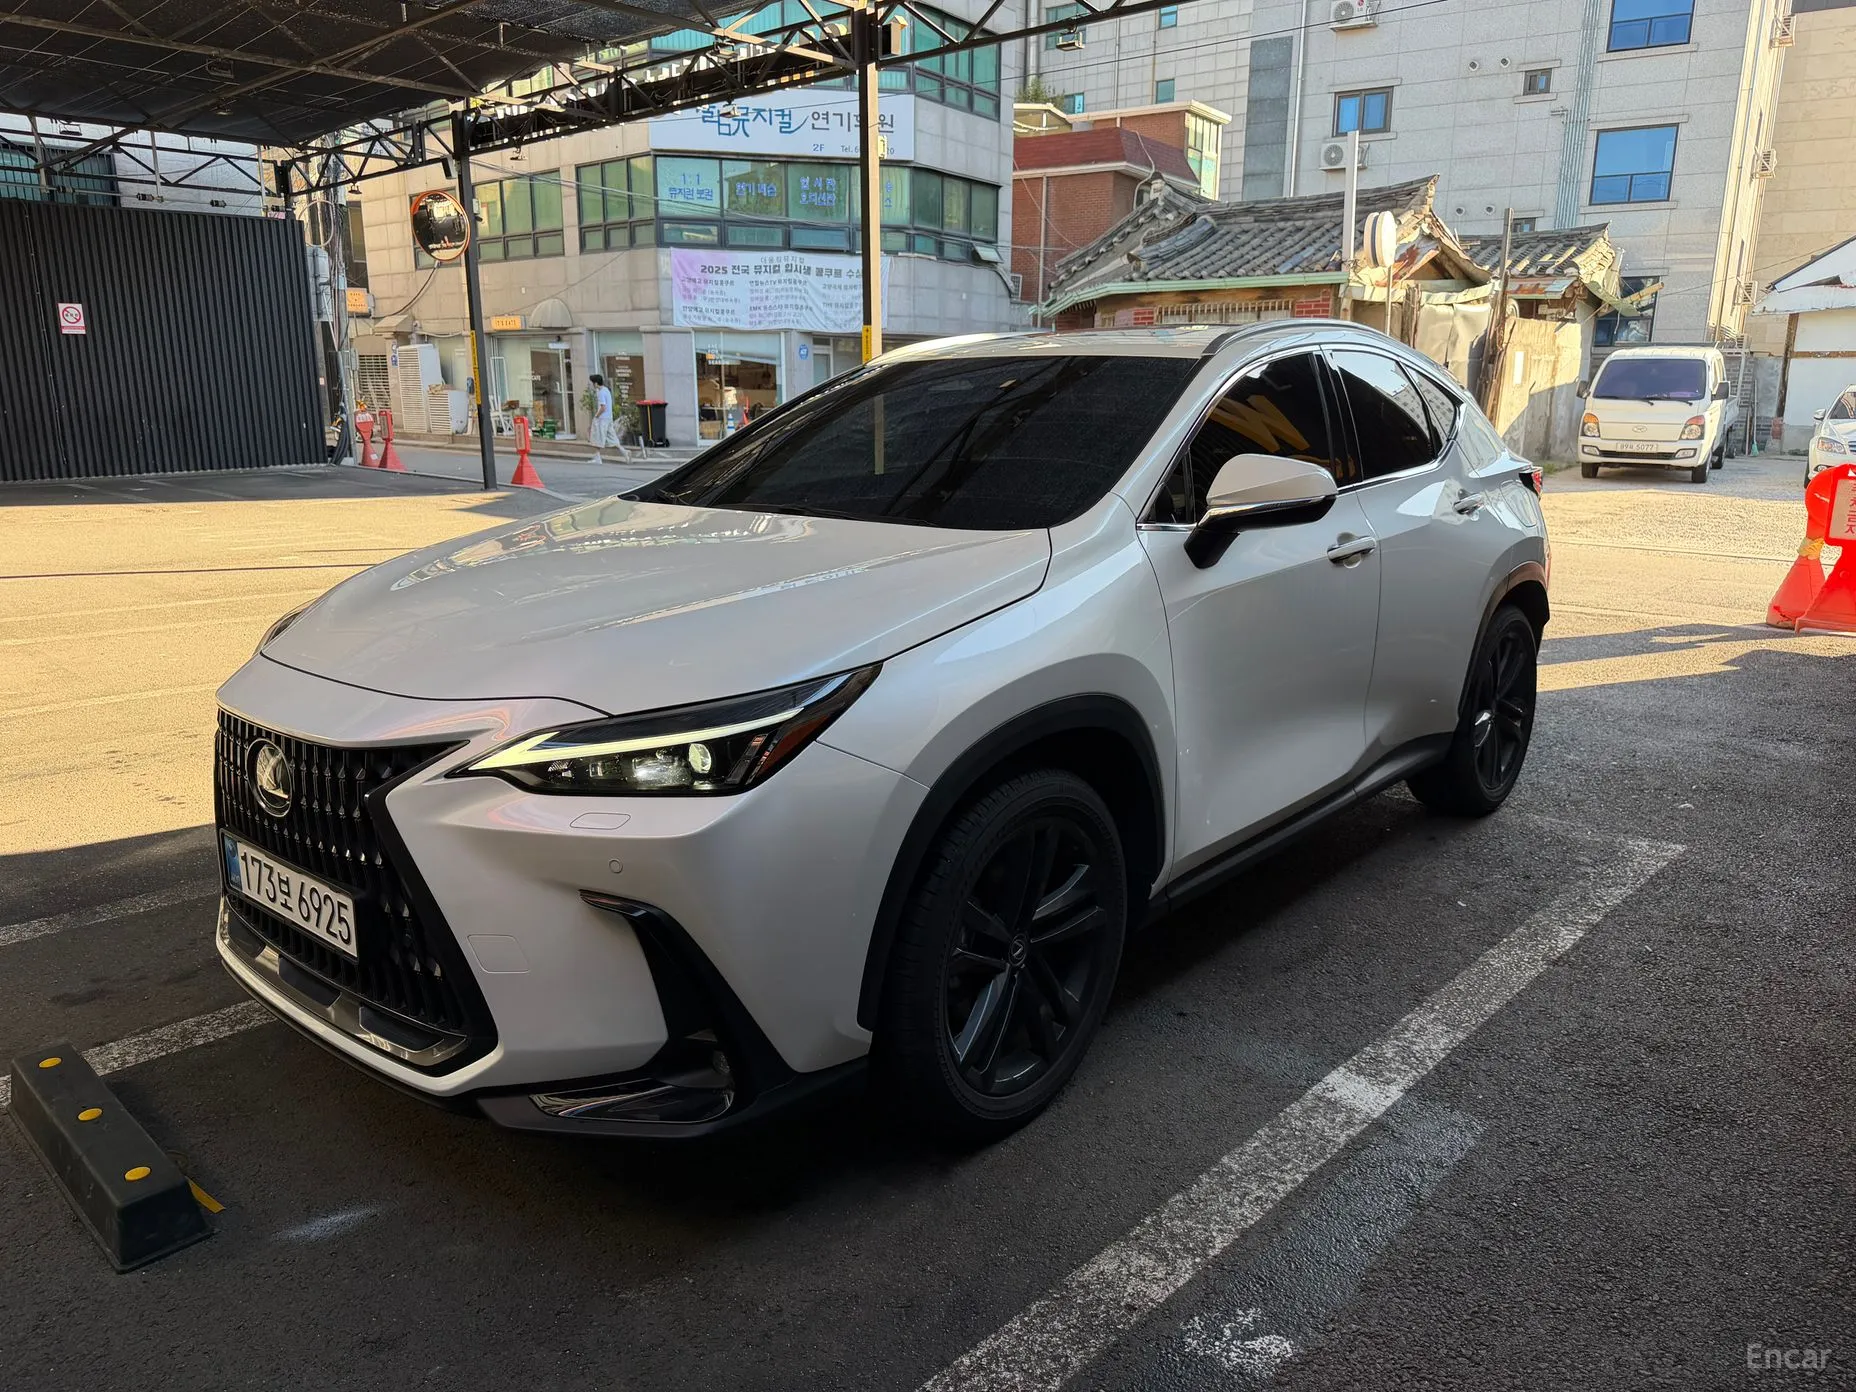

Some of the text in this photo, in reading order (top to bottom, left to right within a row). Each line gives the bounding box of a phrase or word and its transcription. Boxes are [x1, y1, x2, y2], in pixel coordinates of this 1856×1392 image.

[812, 143, 825, 152] 2F
[700, 264, 728, 275] 2025
[731, 264, 750, 276] 전국
[753, 264, 781, 275] 뮤지컬
